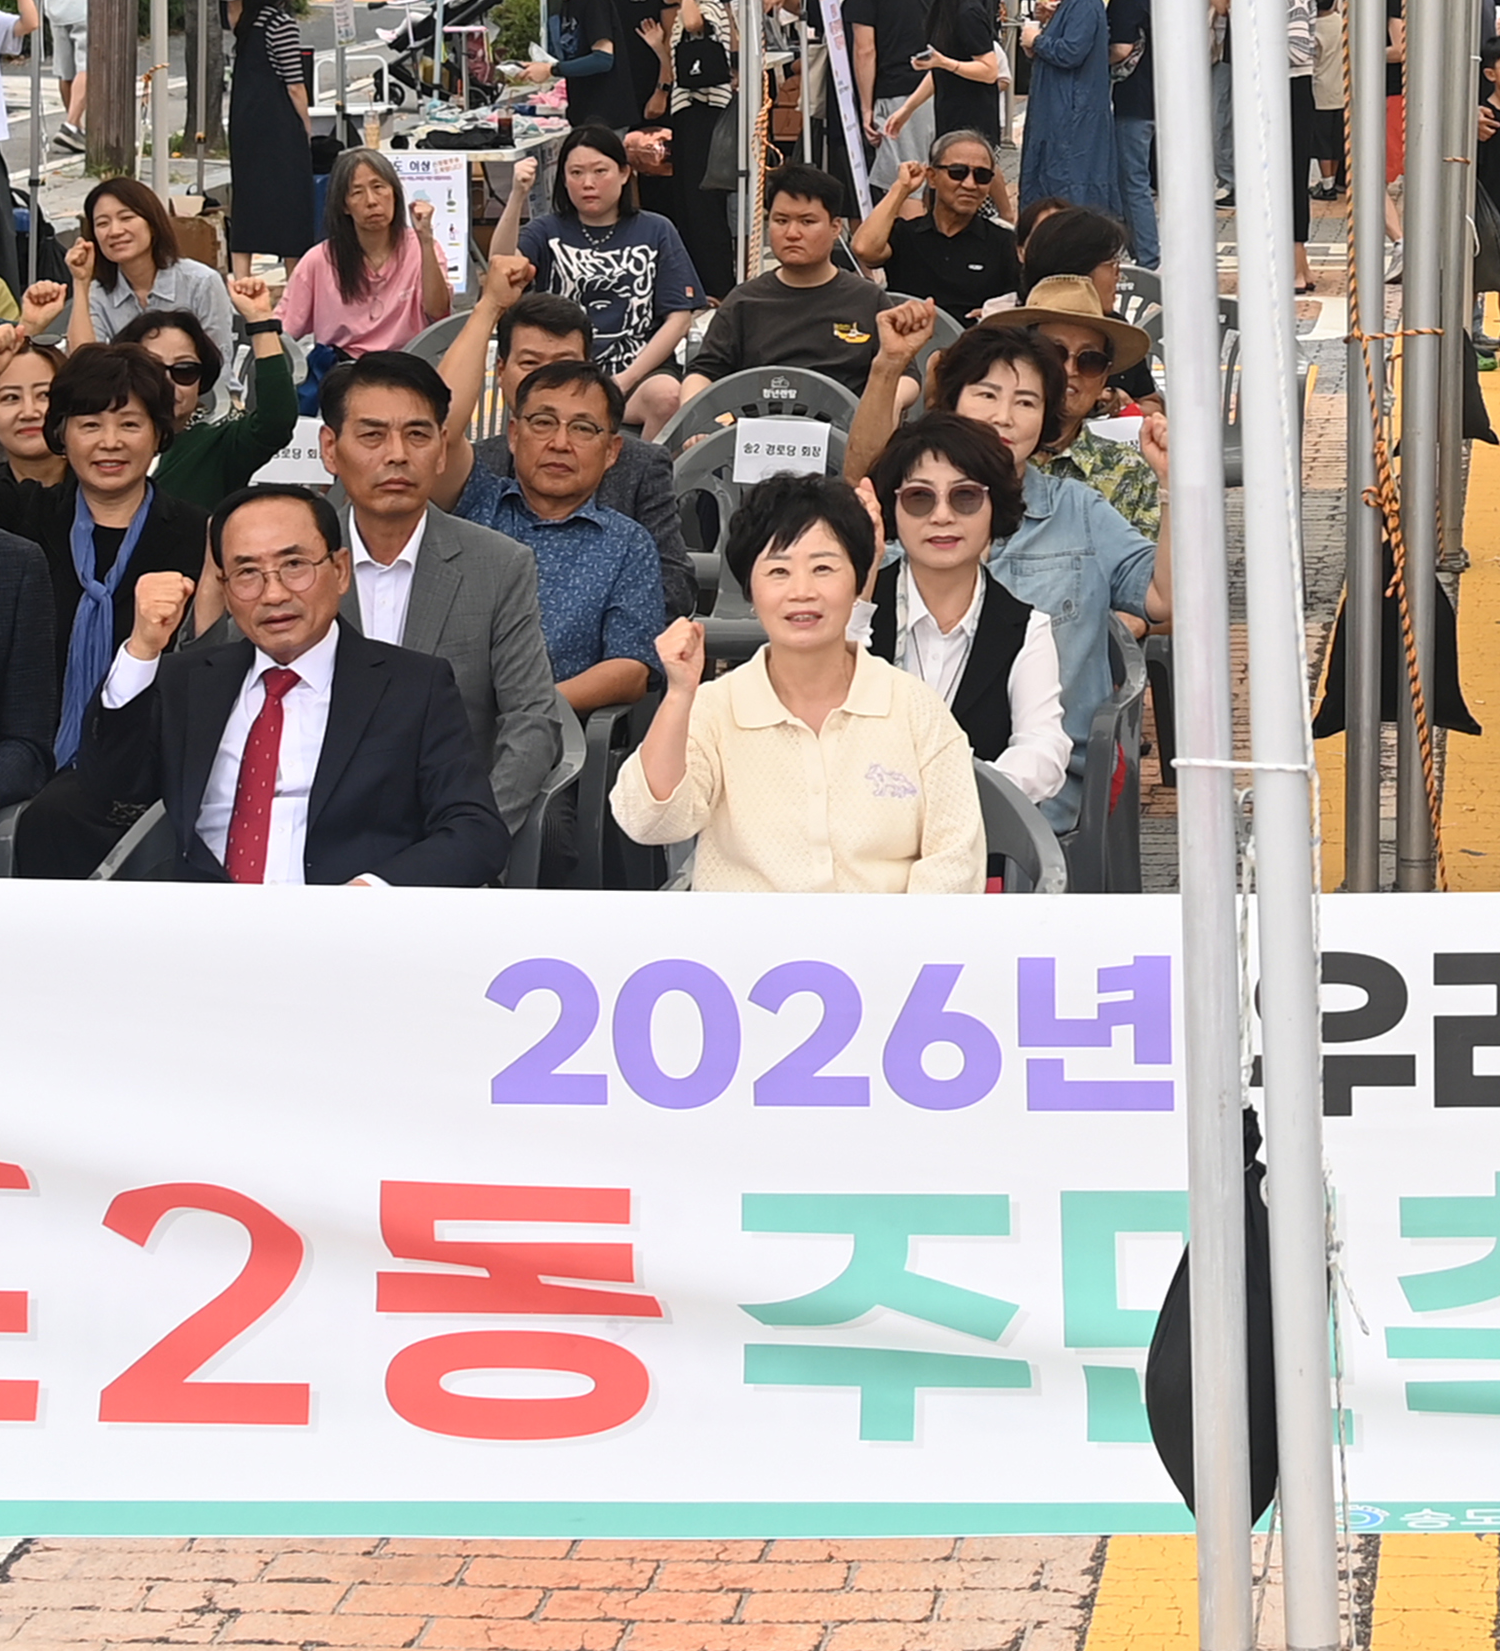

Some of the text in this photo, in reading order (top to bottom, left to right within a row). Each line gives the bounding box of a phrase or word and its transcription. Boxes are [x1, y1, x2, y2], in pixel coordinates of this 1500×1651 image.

[409, 159, 431, 173] 이상
[765, 443, 796, 457] 경로당
[801, 445, 822, 458] 회장
[486, 955, 1175, 1112] 2026년
